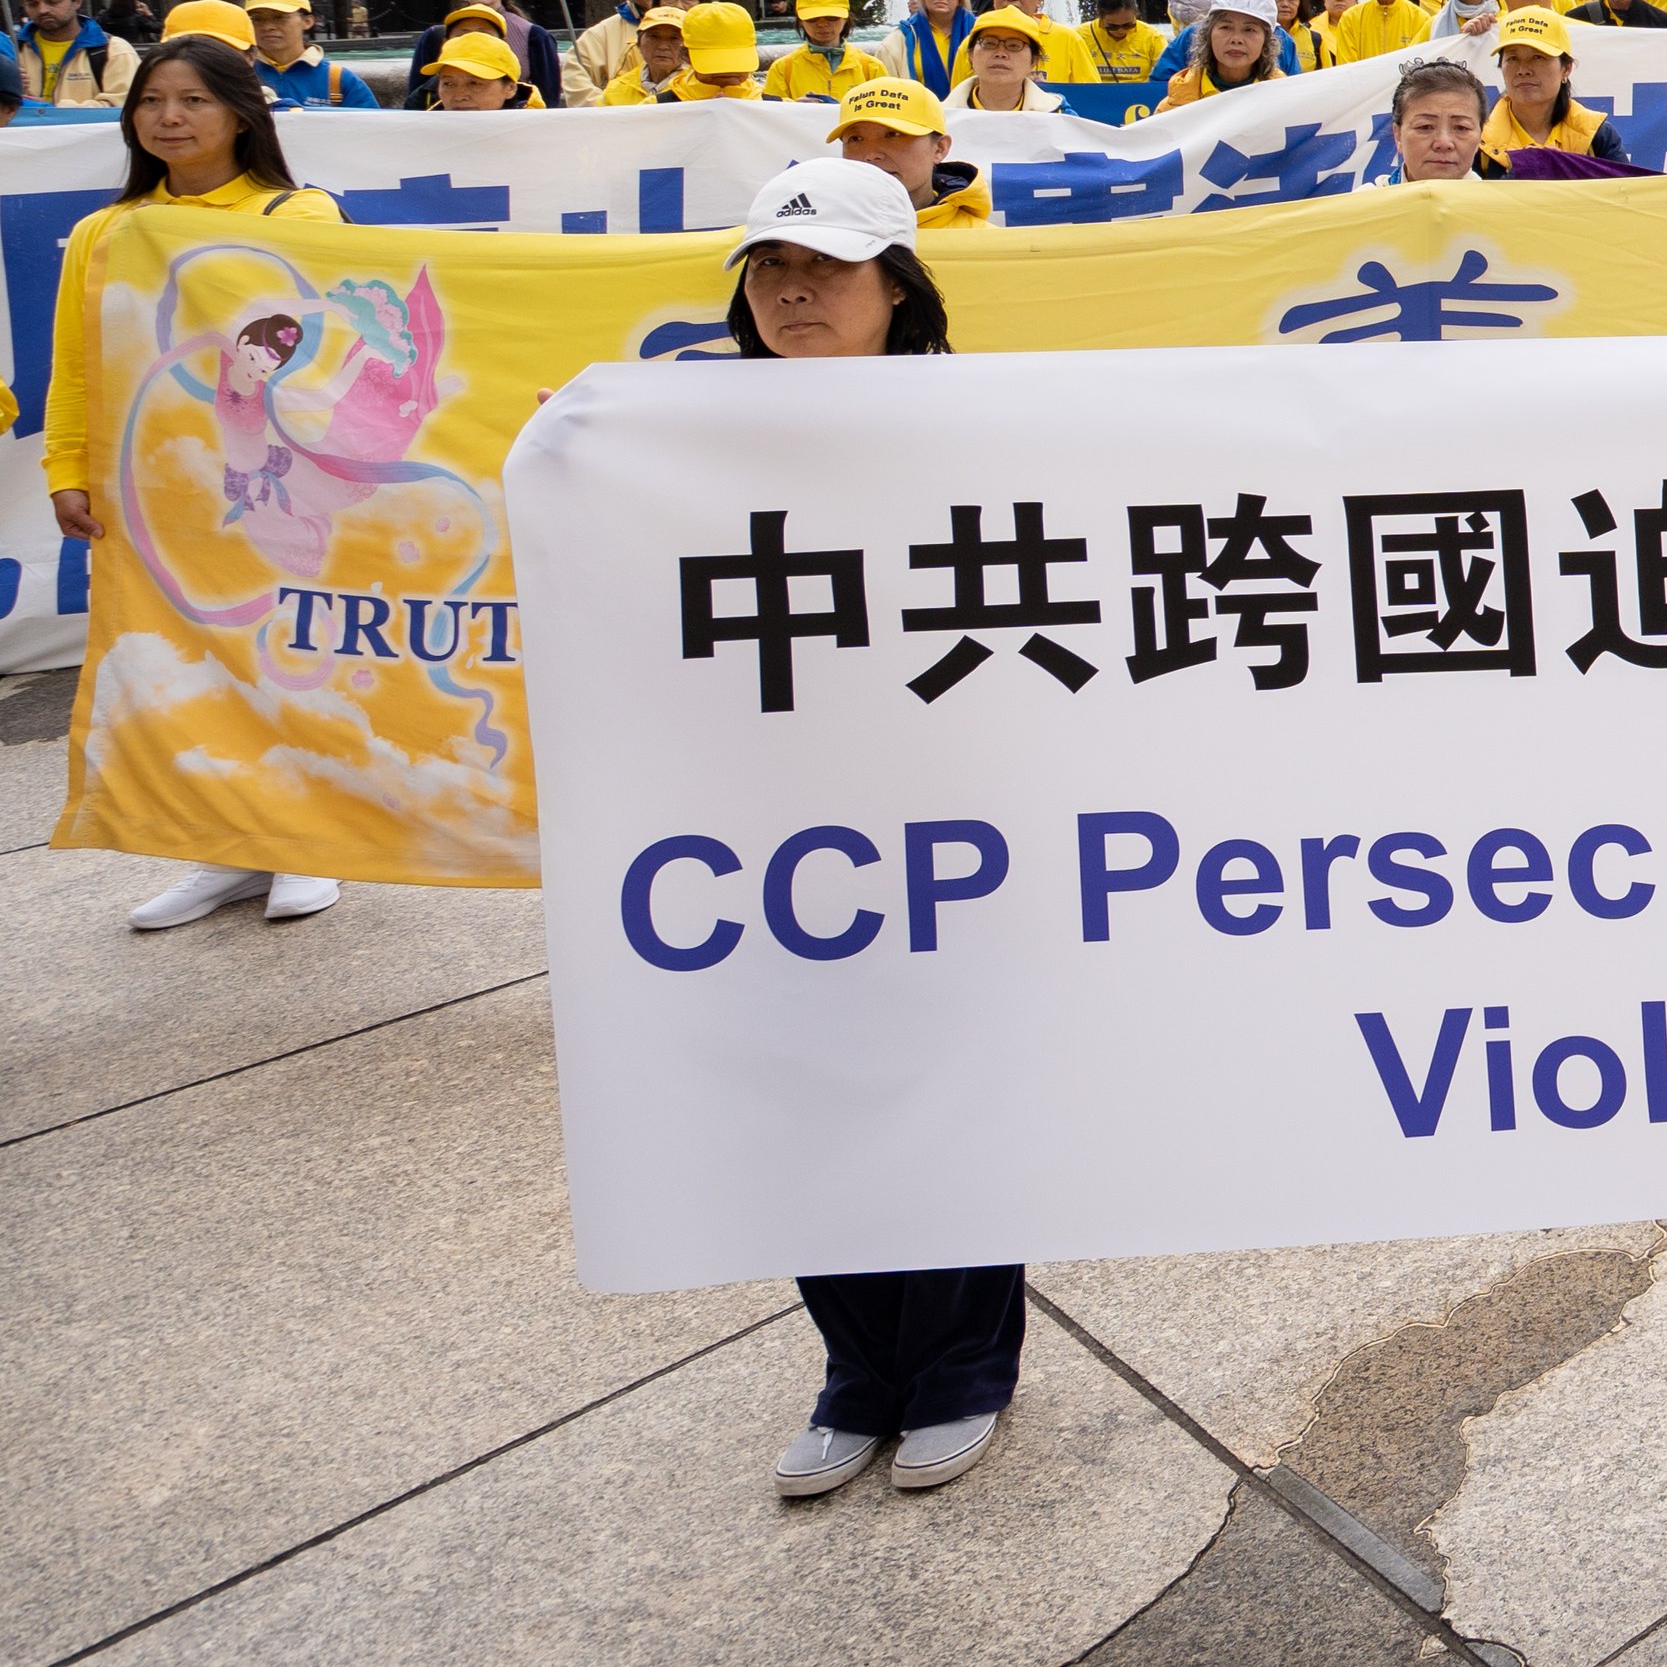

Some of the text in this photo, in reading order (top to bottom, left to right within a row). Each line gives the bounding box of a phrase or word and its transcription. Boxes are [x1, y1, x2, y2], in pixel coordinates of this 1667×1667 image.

[1528, 17, 1549, 28] Dafa
[1518, 25, 1543, 34] Great
[848, 89, 910, 105] Falun Dafa
[854, 100, 902, 113] is Great
[775, 206, 818, 218] adidas
[619, 819, 1010, 973] CCP
